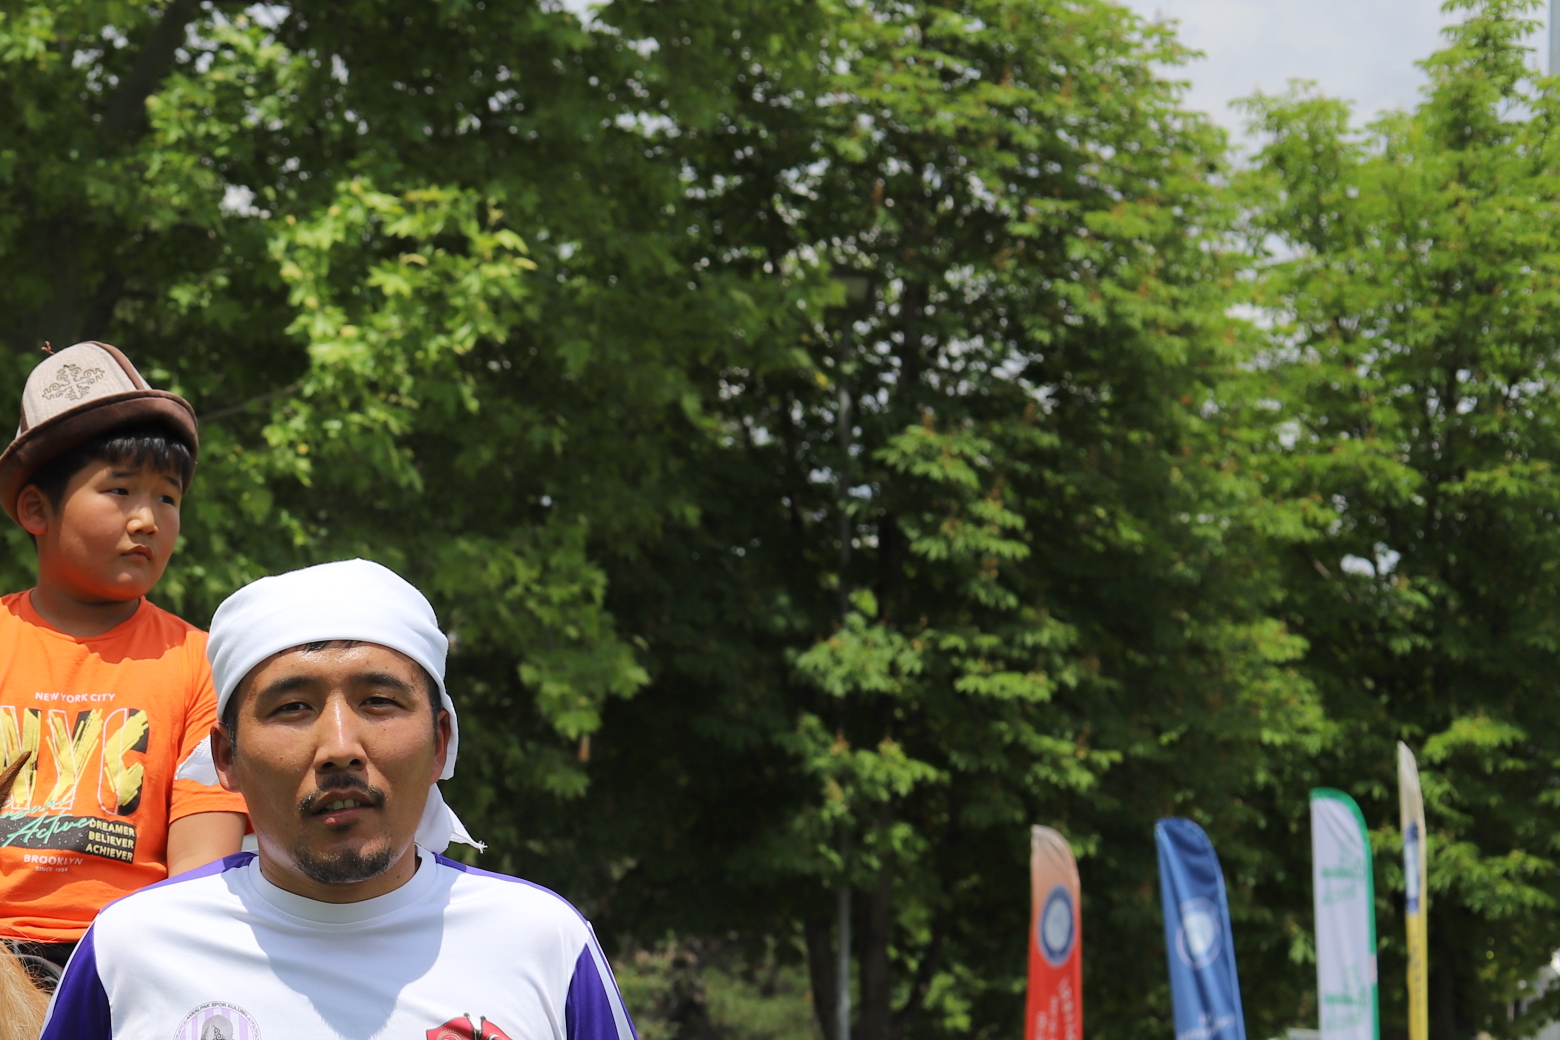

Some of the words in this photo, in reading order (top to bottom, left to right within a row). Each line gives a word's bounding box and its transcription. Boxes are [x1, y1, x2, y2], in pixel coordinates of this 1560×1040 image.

[35, 692, 59, 701] NEW
[60, 692, 88, 703] YORK
[90, 693, 116, 702] CITY
[1, 809, 94, 848] Active
[89, 818, 135, 837] DREAMER
[88, 831, 134, 848] BELIEVER
[23, 854, 83, 865] BROOKLYN
[85, 843, 133, 861] ACHIEVER
